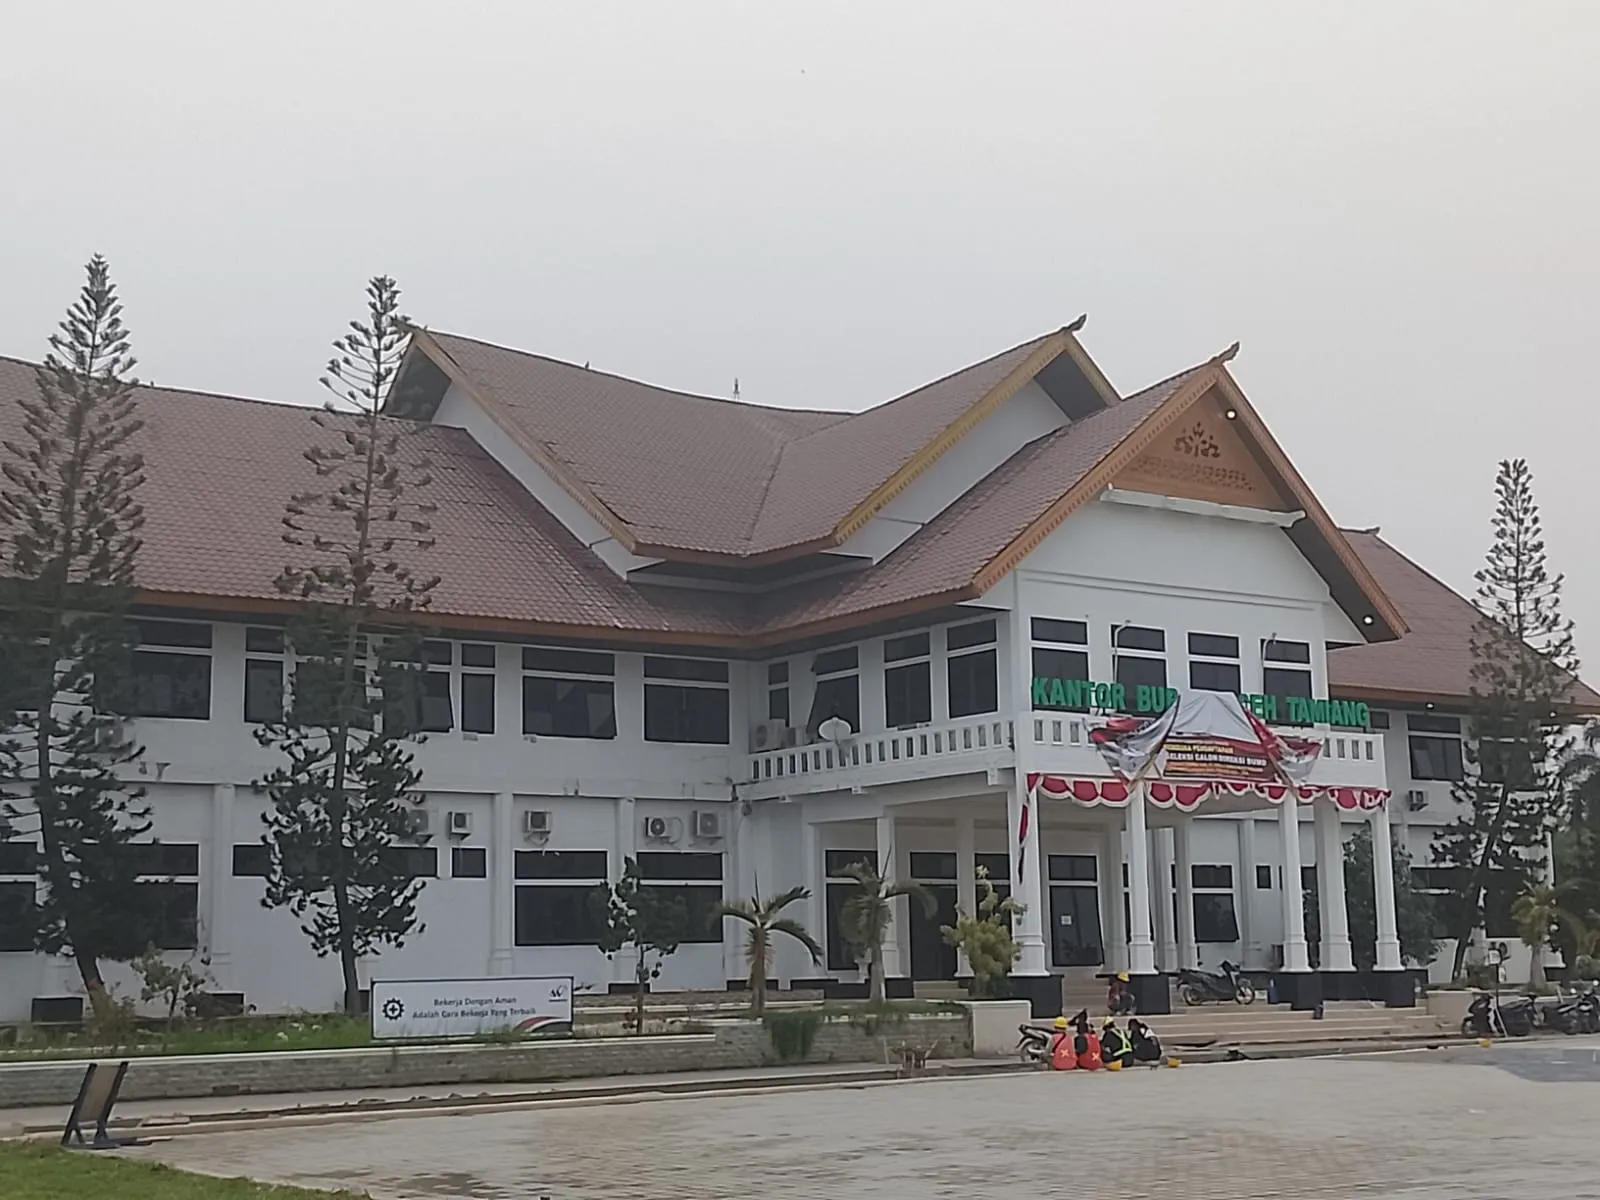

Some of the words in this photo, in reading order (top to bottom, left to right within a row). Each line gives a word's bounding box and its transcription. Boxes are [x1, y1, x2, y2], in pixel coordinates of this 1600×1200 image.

[1032, 678, 1125, 710] KANTOR
[1136, 685, 1178, 712] BUP
[1285, 696, 1370, 726] TAMIANG
[433, 999, 463, 1007] Bekerja
[464, 998, 493, 1006] Dengan
[495, 996, 517, 1004] Aman
